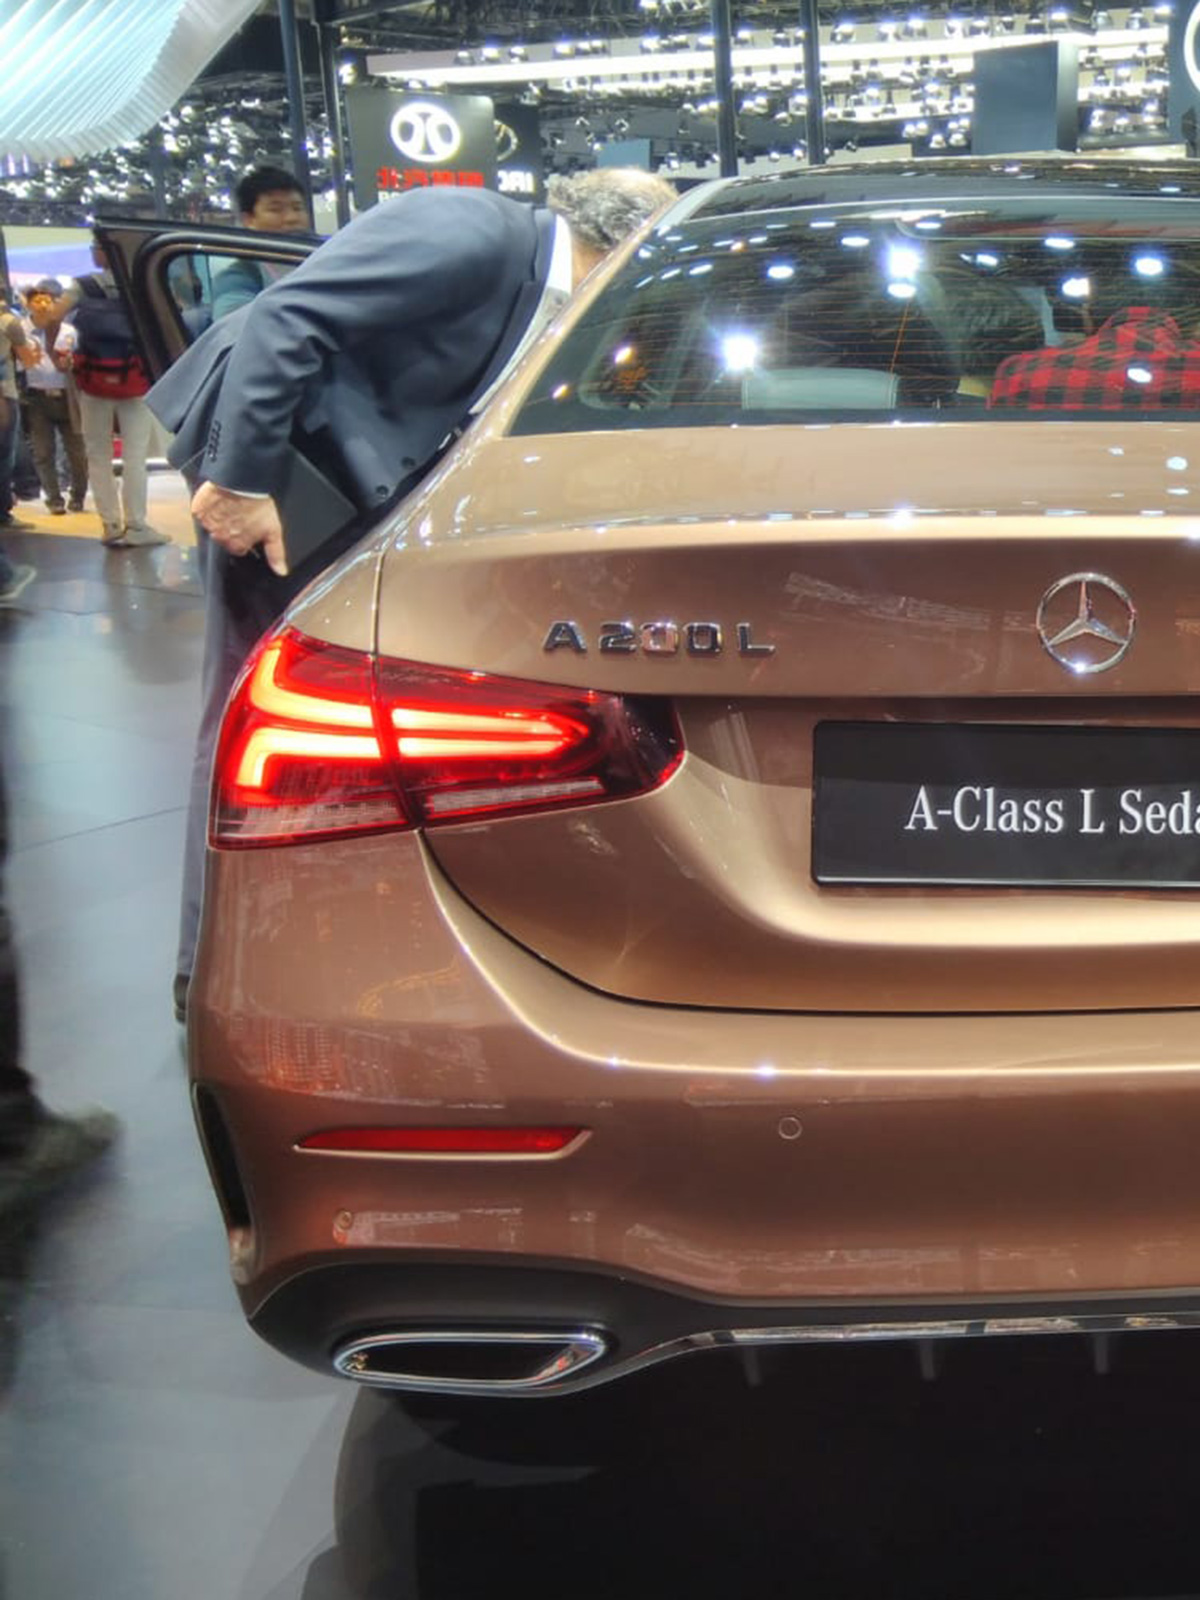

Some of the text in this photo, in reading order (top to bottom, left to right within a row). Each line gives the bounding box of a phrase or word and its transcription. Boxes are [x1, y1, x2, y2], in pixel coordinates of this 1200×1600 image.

[736, 622, 776, 654] L
[904, 785, 1063, 832] A-Class
[1079, 788, 1105, 833] L
